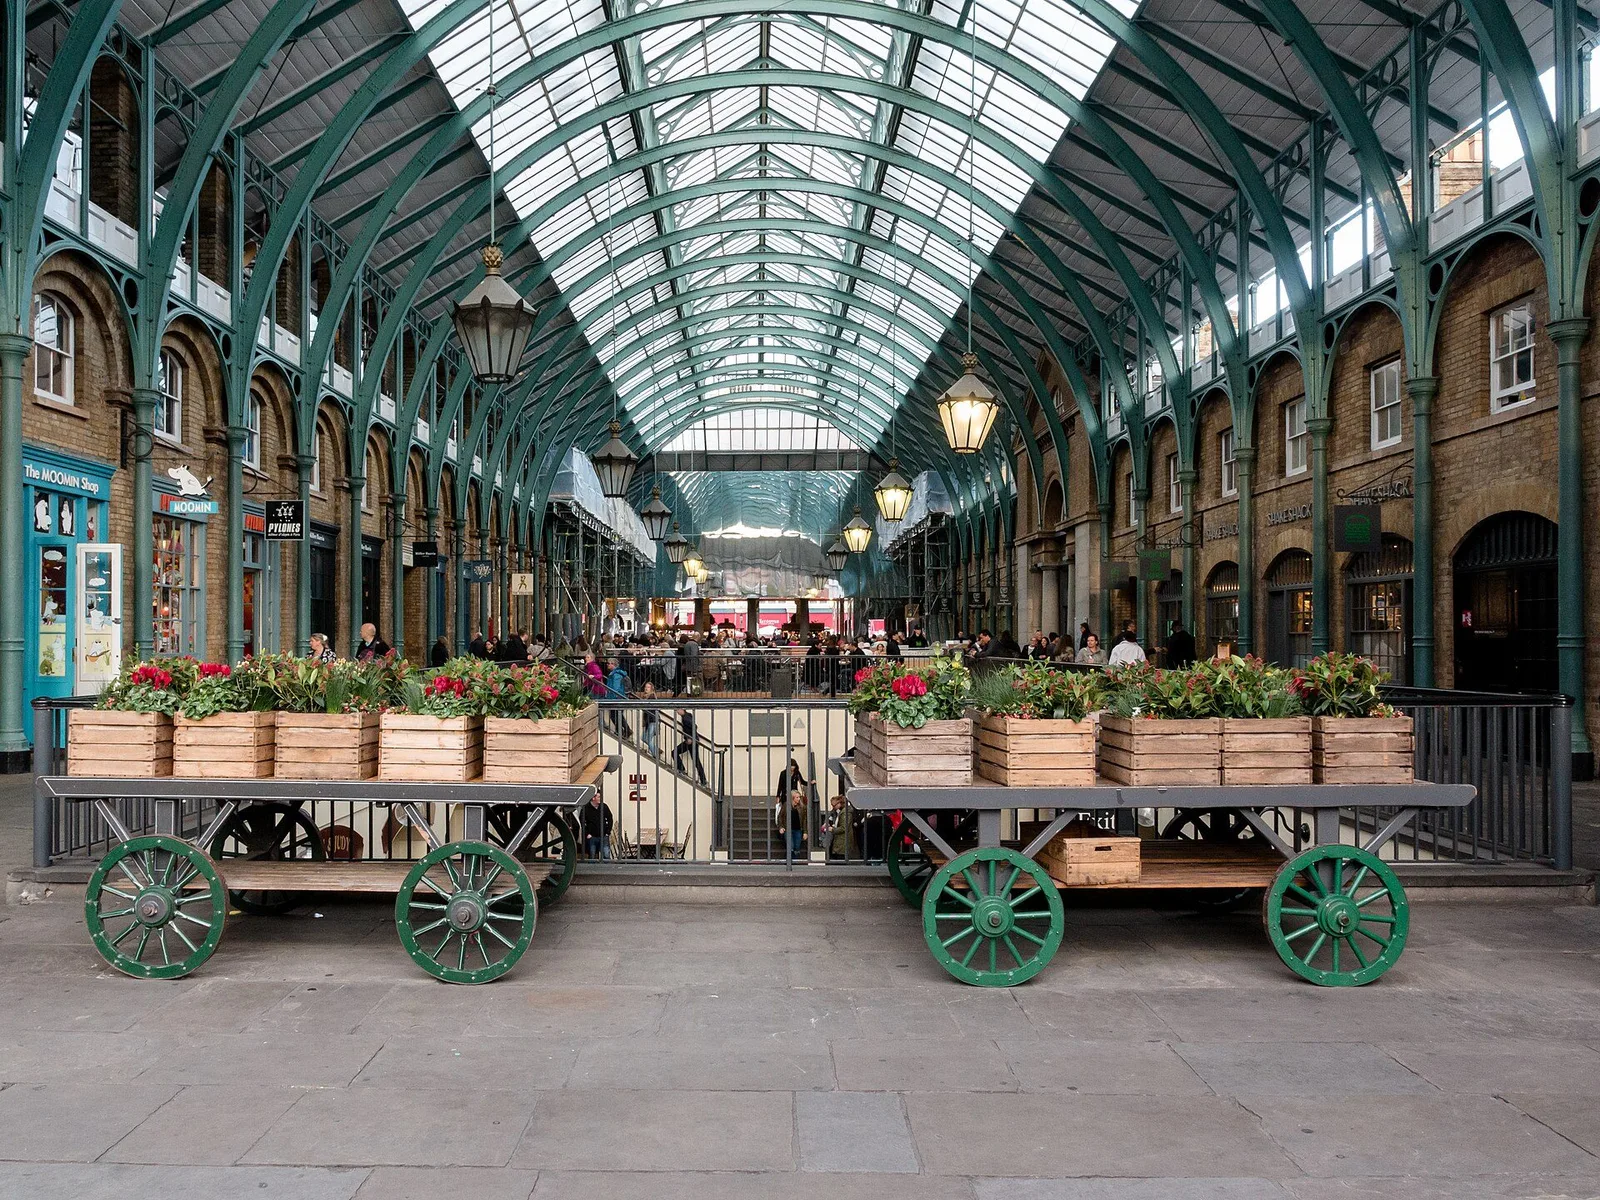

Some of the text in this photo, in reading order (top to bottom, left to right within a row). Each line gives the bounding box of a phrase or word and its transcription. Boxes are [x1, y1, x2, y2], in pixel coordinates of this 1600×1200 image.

[25, 464, 99, 495] The MOOMIN Shop
[174, 501, 211, 512] MOOMIN
[1266, 503, 1312, 527] SHAKE SHACK
[268, 522, 301, 533] PYLONES
